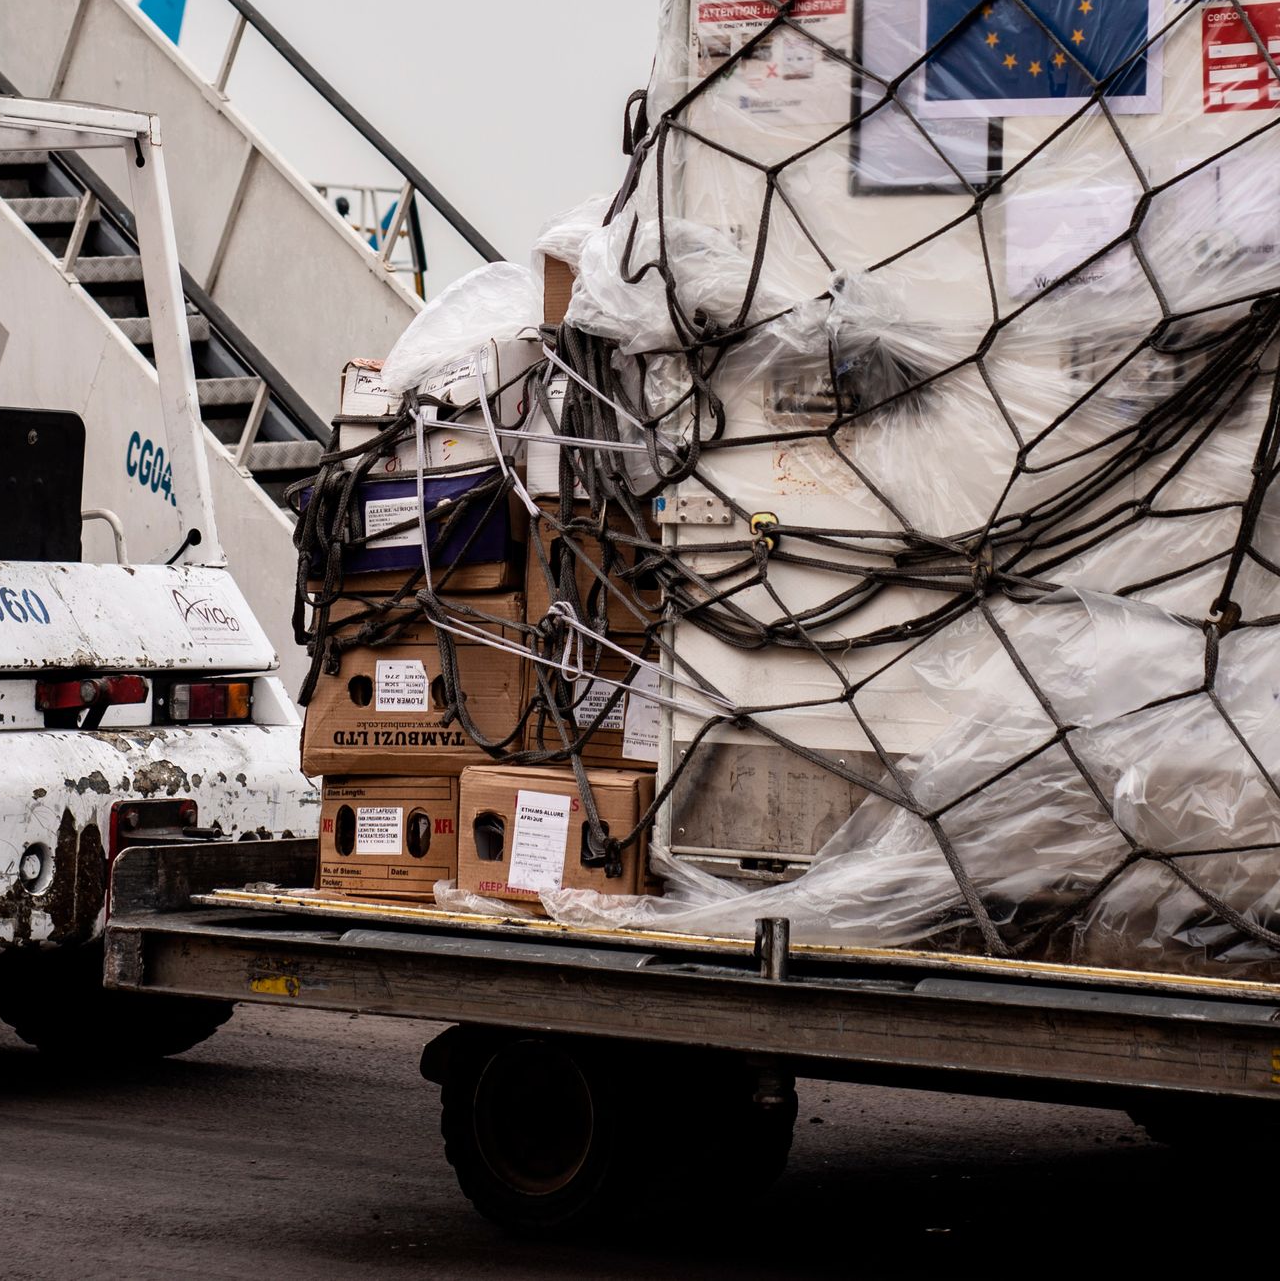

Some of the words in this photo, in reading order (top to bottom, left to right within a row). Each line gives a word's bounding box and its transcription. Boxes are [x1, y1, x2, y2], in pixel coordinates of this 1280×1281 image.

[703, 4, 760, 19] ATTENTION:
[126, 430, 177, 507] CG04
[396, 697, 424, 705] FLOWER
[333, 730, 370, 746] LTD
[373, 730, 466, 747] TAMBUZI
[341, 789, 366, 797] Length:
[322, 818, 334, 834] XFL
[434, 818, 455, 834] XFL
[520, 815, 543, 823] AFRIQUE
[322, 878, 343, 887] Packer:
[478, 881, 503, 893] KEEP
